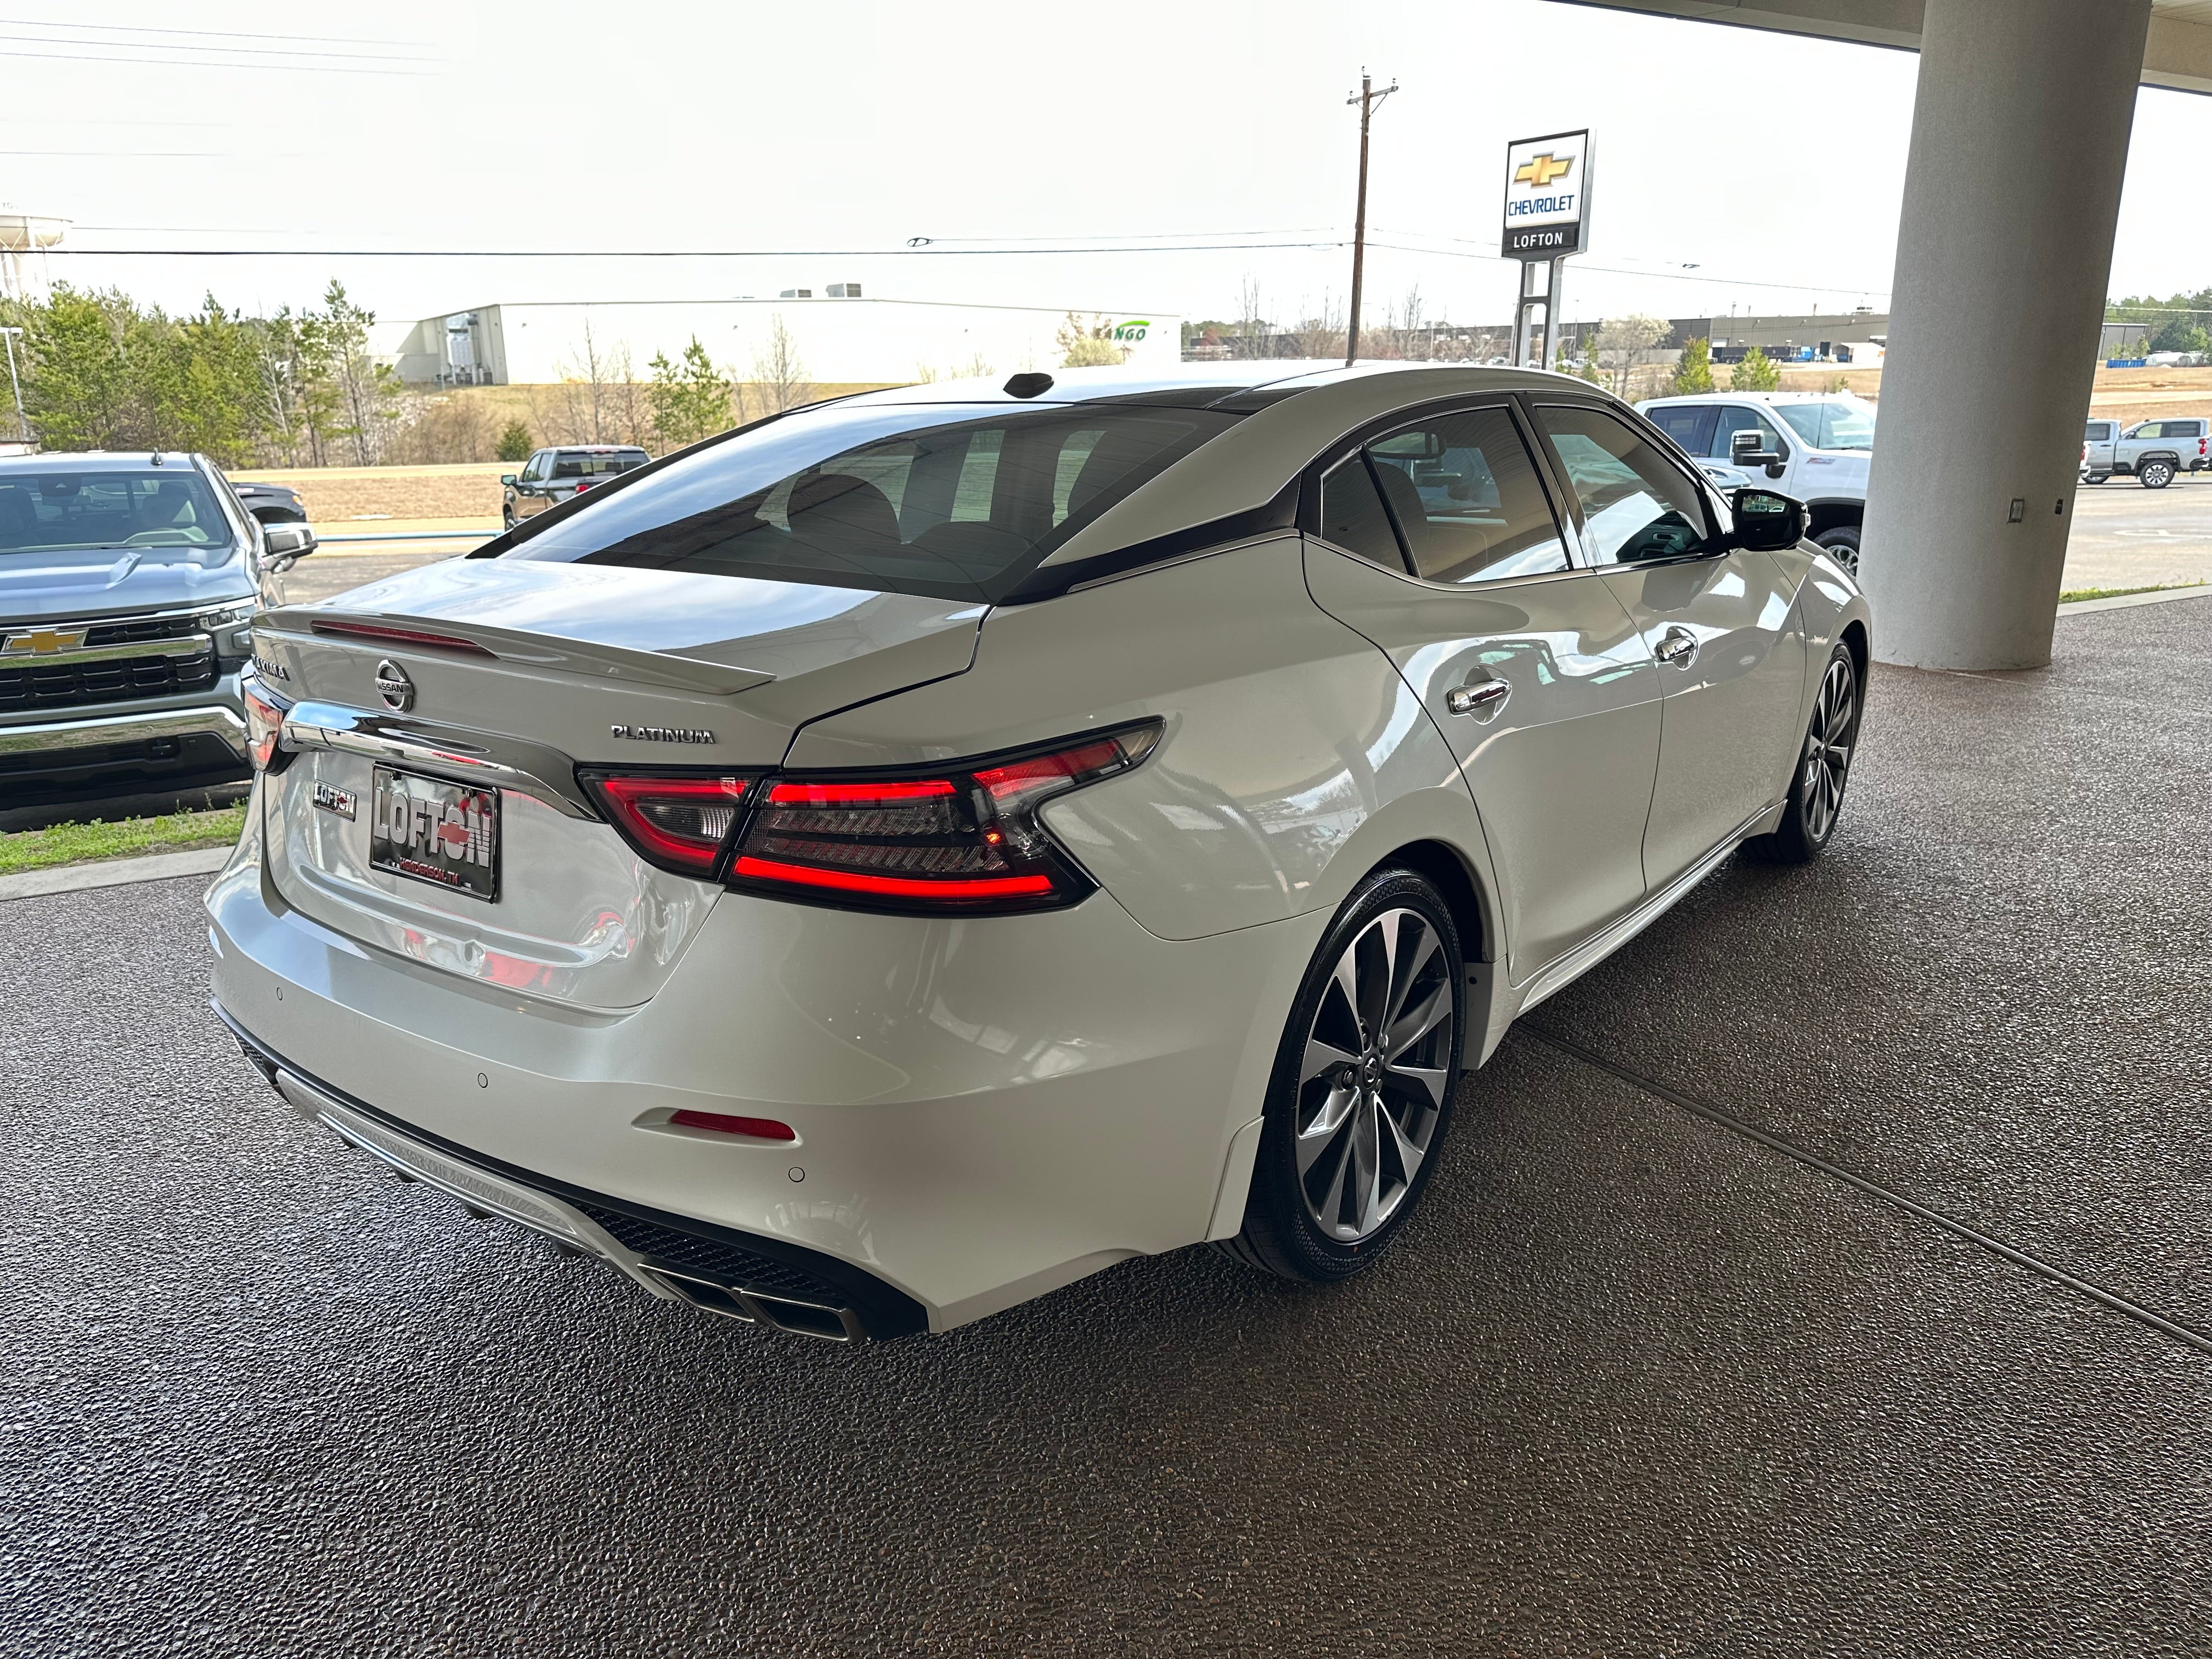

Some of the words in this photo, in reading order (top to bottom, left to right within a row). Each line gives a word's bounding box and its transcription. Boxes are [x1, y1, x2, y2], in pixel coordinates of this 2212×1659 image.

[1508, 195, 1575, 216] CHEVROLET
[1513, 232, 1563, 249] LOFTON
[377, 681, 404, 693] NISSAN
[611, 724, 715, 744] PLATINUM
[314, 782, 356, 814] LOFTON
[374, 786, 492, 868] LOFTON
